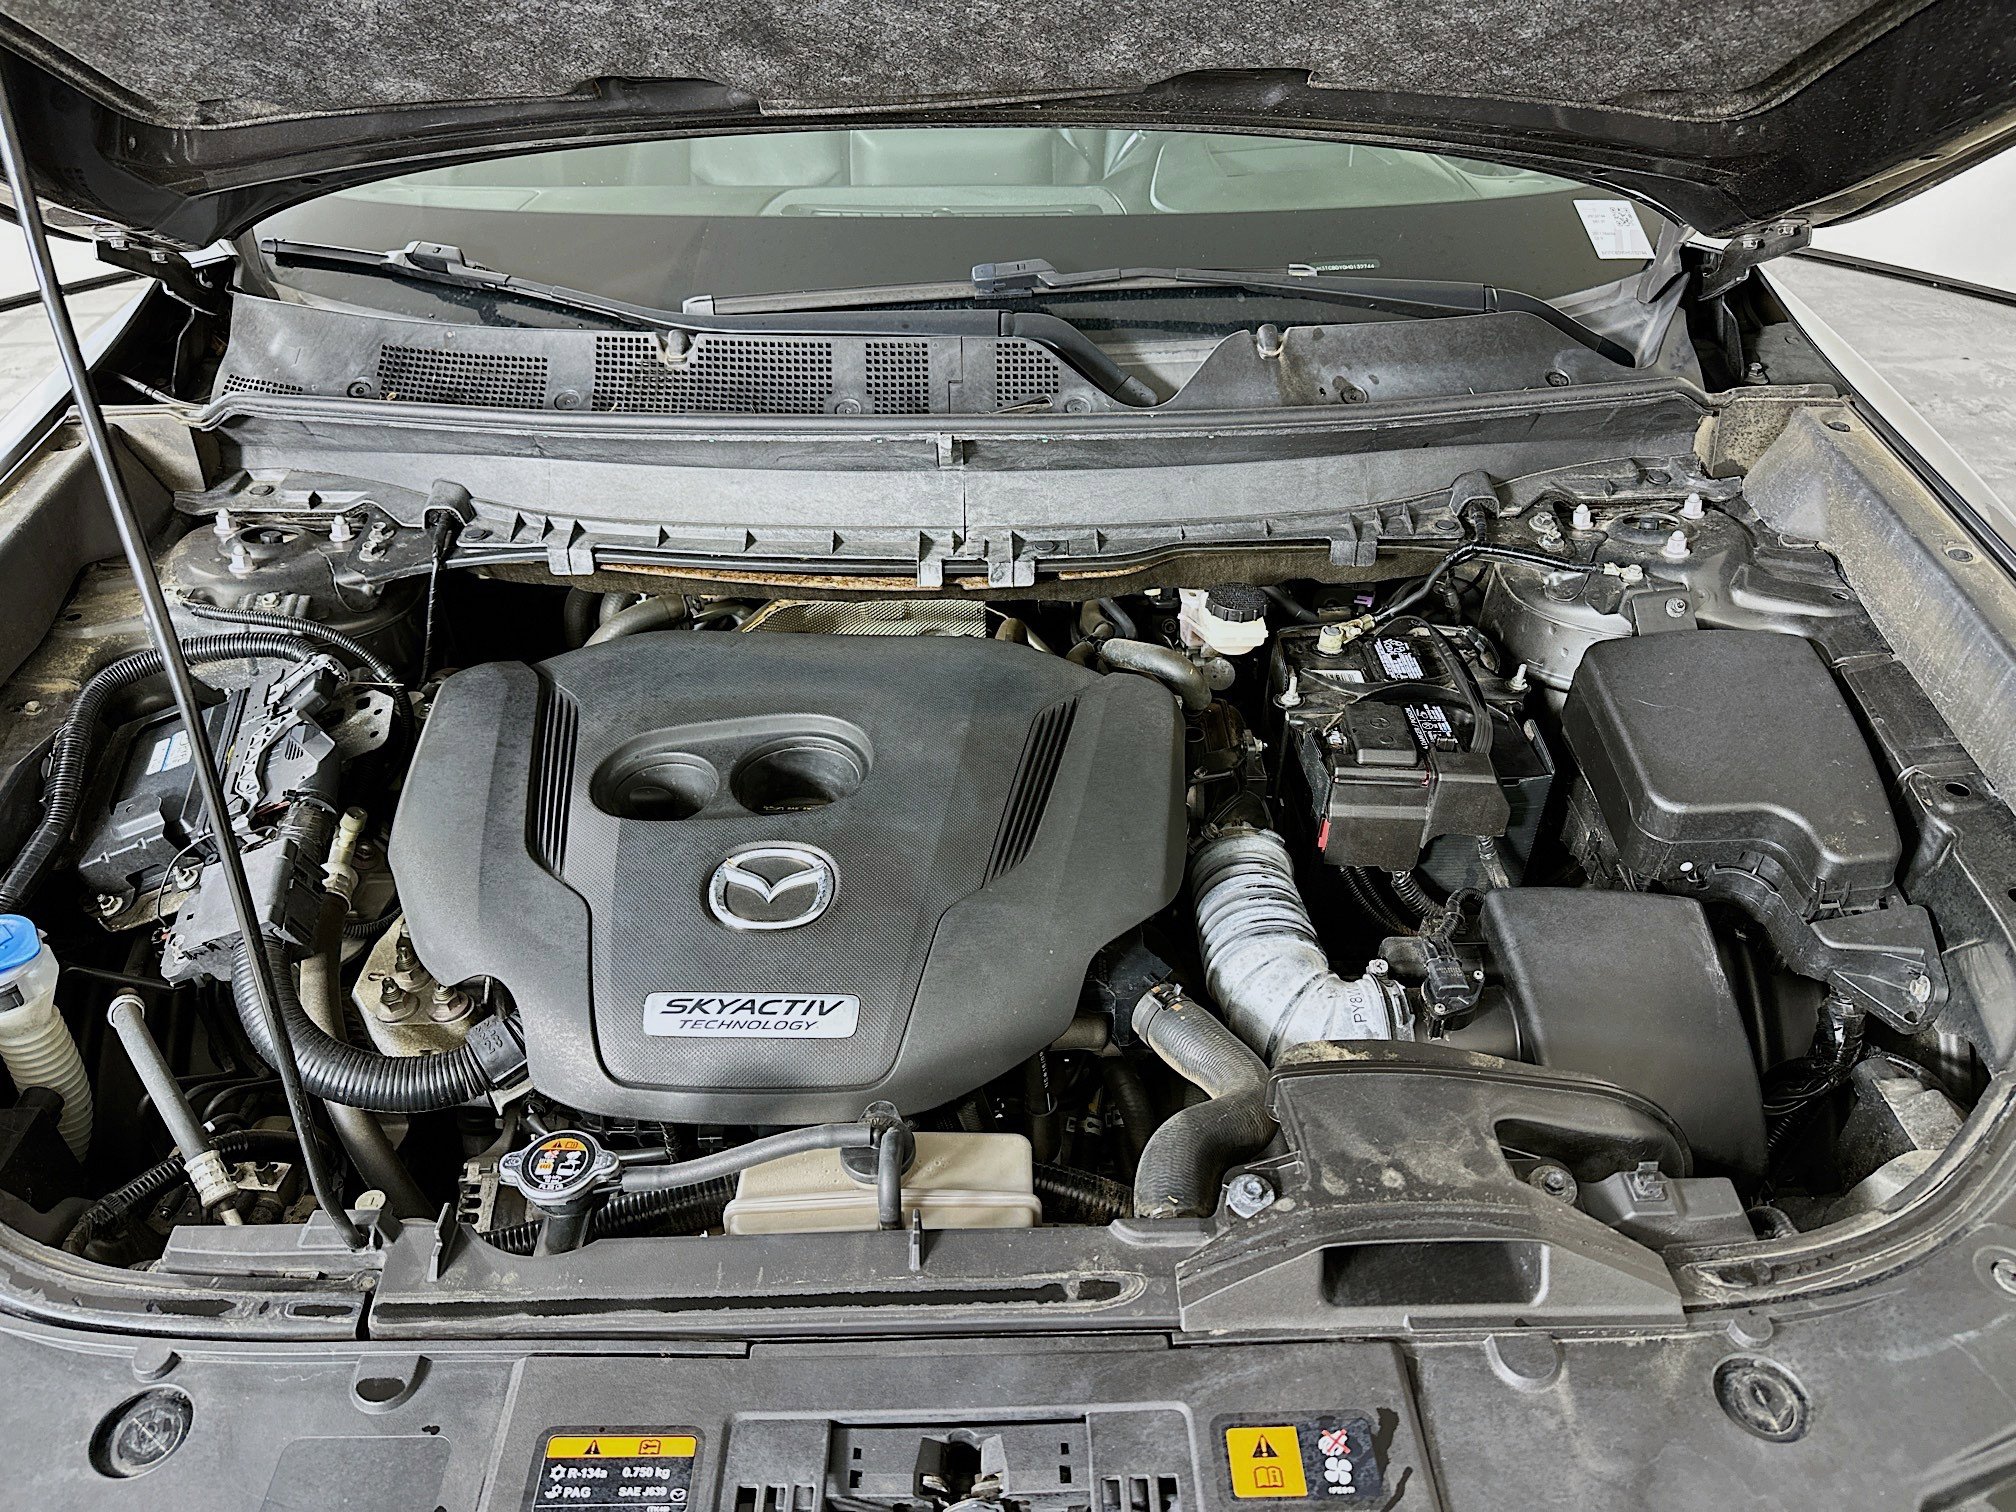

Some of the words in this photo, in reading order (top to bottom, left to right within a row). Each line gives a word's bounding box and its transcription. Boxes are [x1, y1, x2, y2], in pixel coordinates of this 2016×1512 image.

[660, 998, 844, 1016] SKYACTIV
[679, 1019, 818, 1030] TECHNOLOGY
[567, 1467, 608, 1479] R-134a
[622, 1467, 653, 1478] 0.750
[655, 1467, 671, 1480] kg
[563, 1487, 592, 1498] PAG
[618, 1486, 642, 1497] SAE
